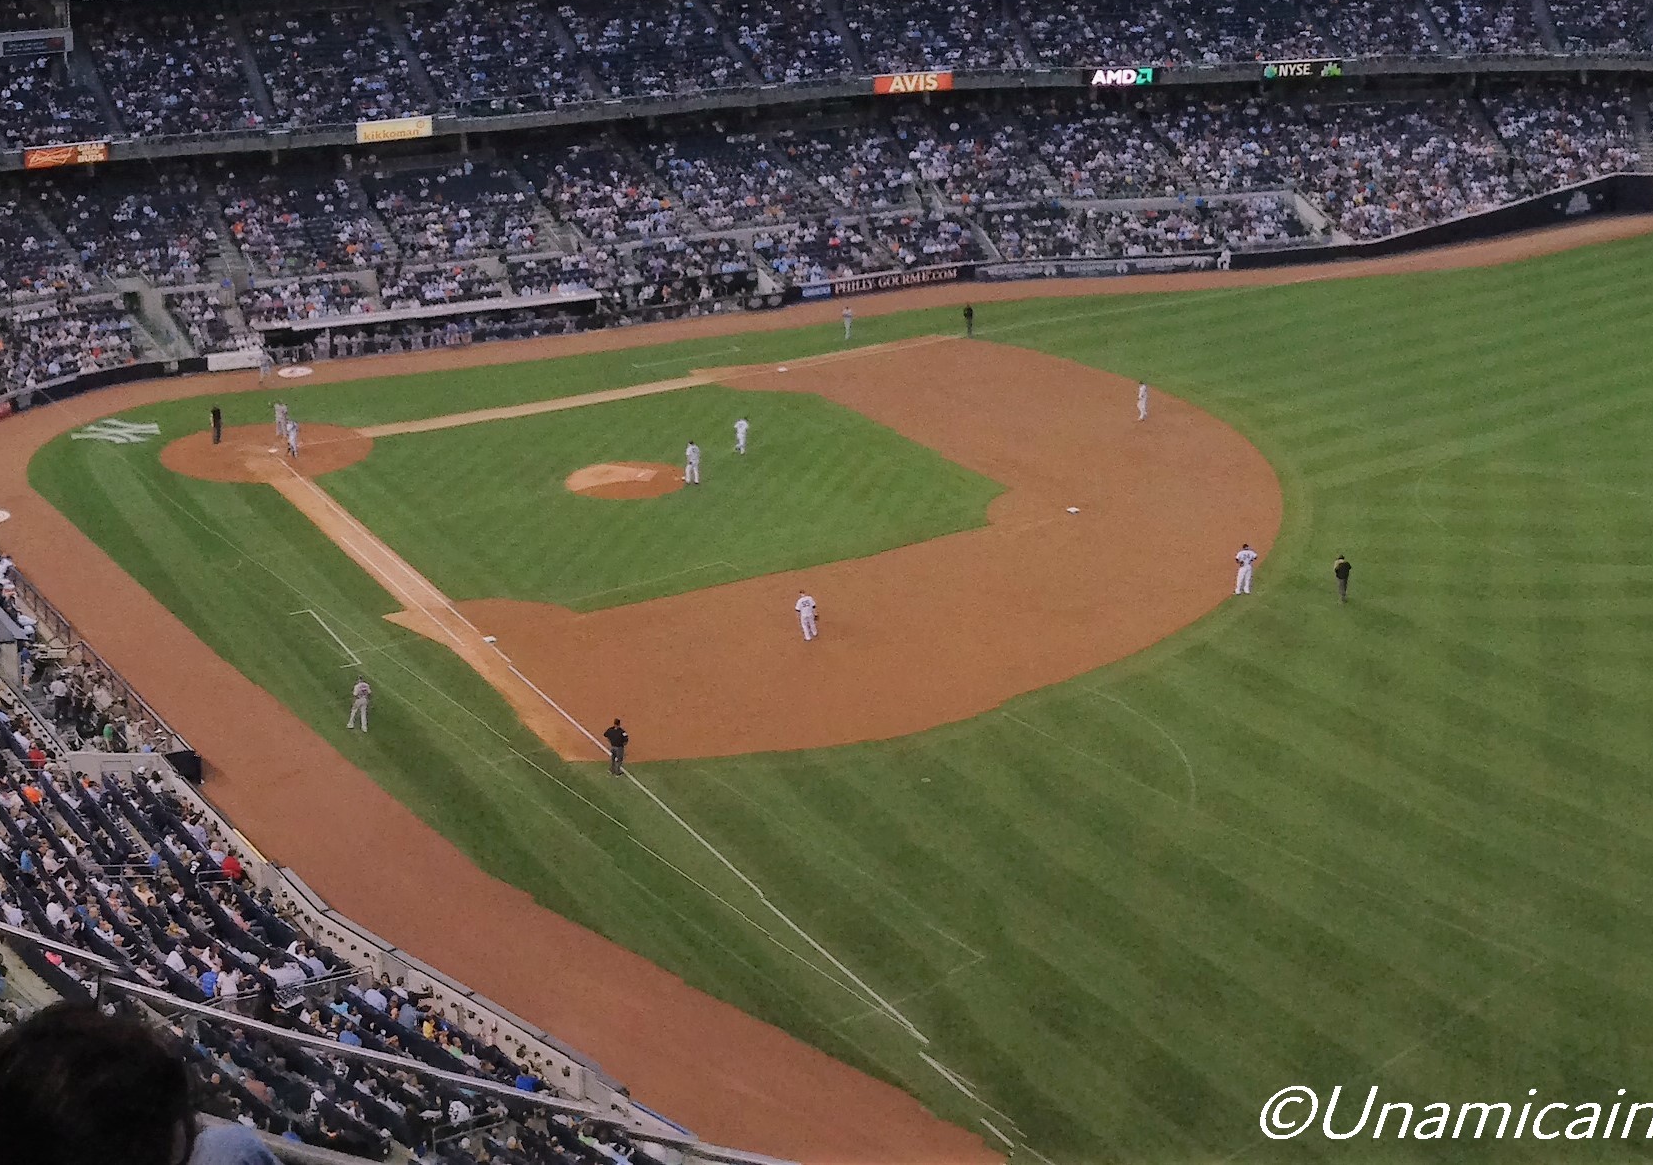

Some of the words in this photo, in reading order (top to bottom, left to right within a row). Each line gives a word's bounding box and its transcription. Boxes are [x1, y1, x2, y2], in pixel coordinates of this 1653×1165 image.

[1091, 70, 1134, 86] AMD
[1278, 63, 1312, 78] NYSE
[888, 74, 939, 93] AVIS
[363, 127, 420, 142] kikkoman
